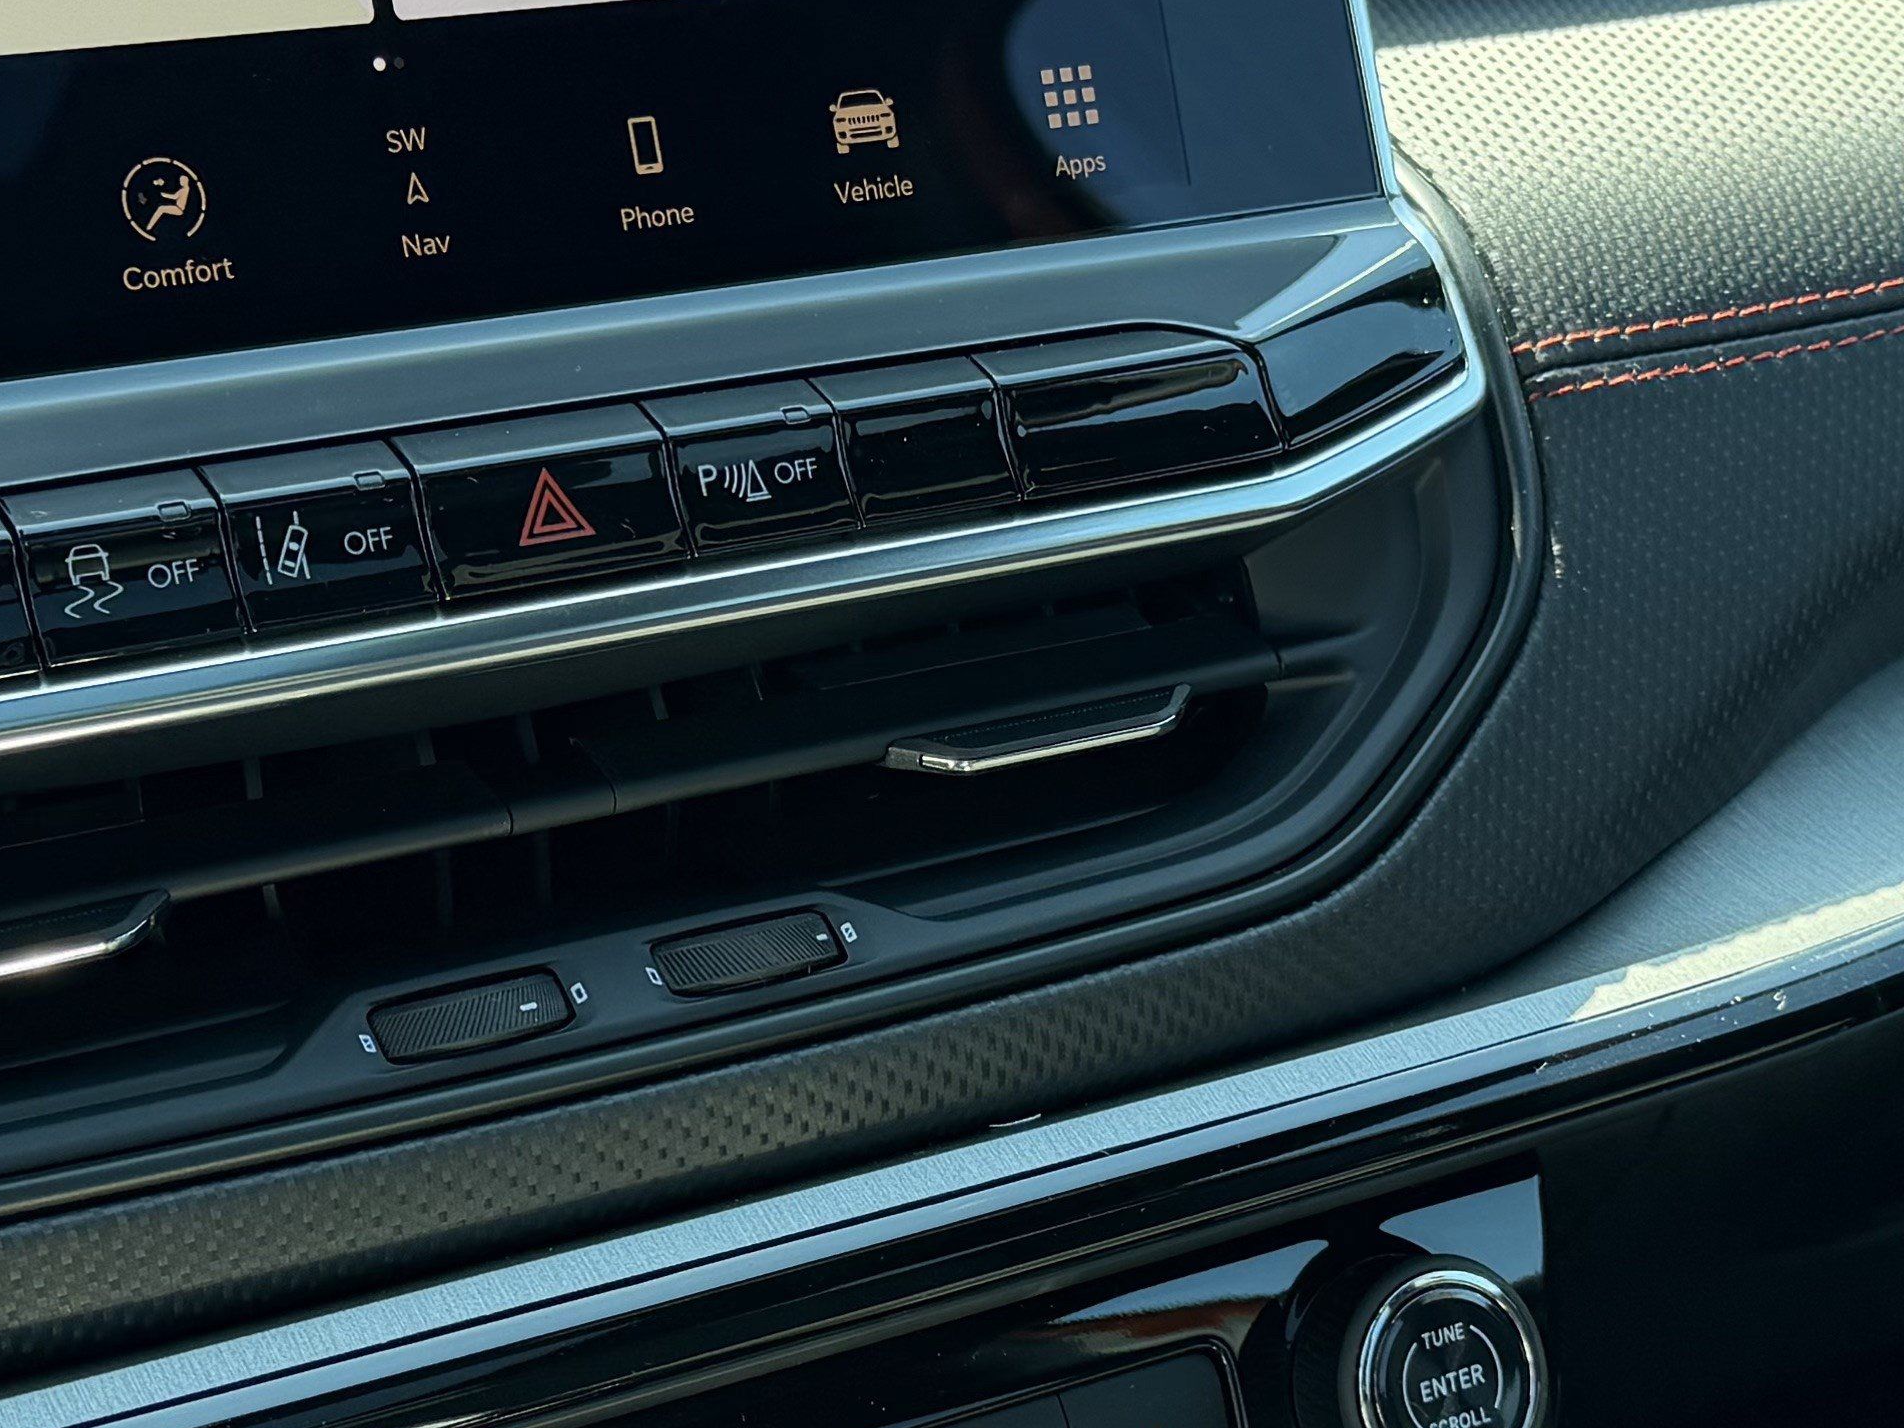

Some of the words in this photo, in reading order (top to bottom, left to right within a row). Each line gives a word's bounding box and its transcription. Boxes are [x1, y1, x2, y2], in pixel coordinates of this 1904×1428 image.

[387, 127, 427, 154] SW
[1056, 152, 1107, 180] Apps
[834, 173, 914, 206] Vehicle
[621, 202, 694, 232] Phone
[401, 232, 450, 258] Nav
[123, 255, 235, 292] Comfort
[774, 457, 818, 484] OFF
[344, 527, 393, 556] OFF
[147, 559, 200, 589] OFF
[1421, 1322, 1466, 1350] TUNE
[1419, 1363, 1486, 1404] ENTER
